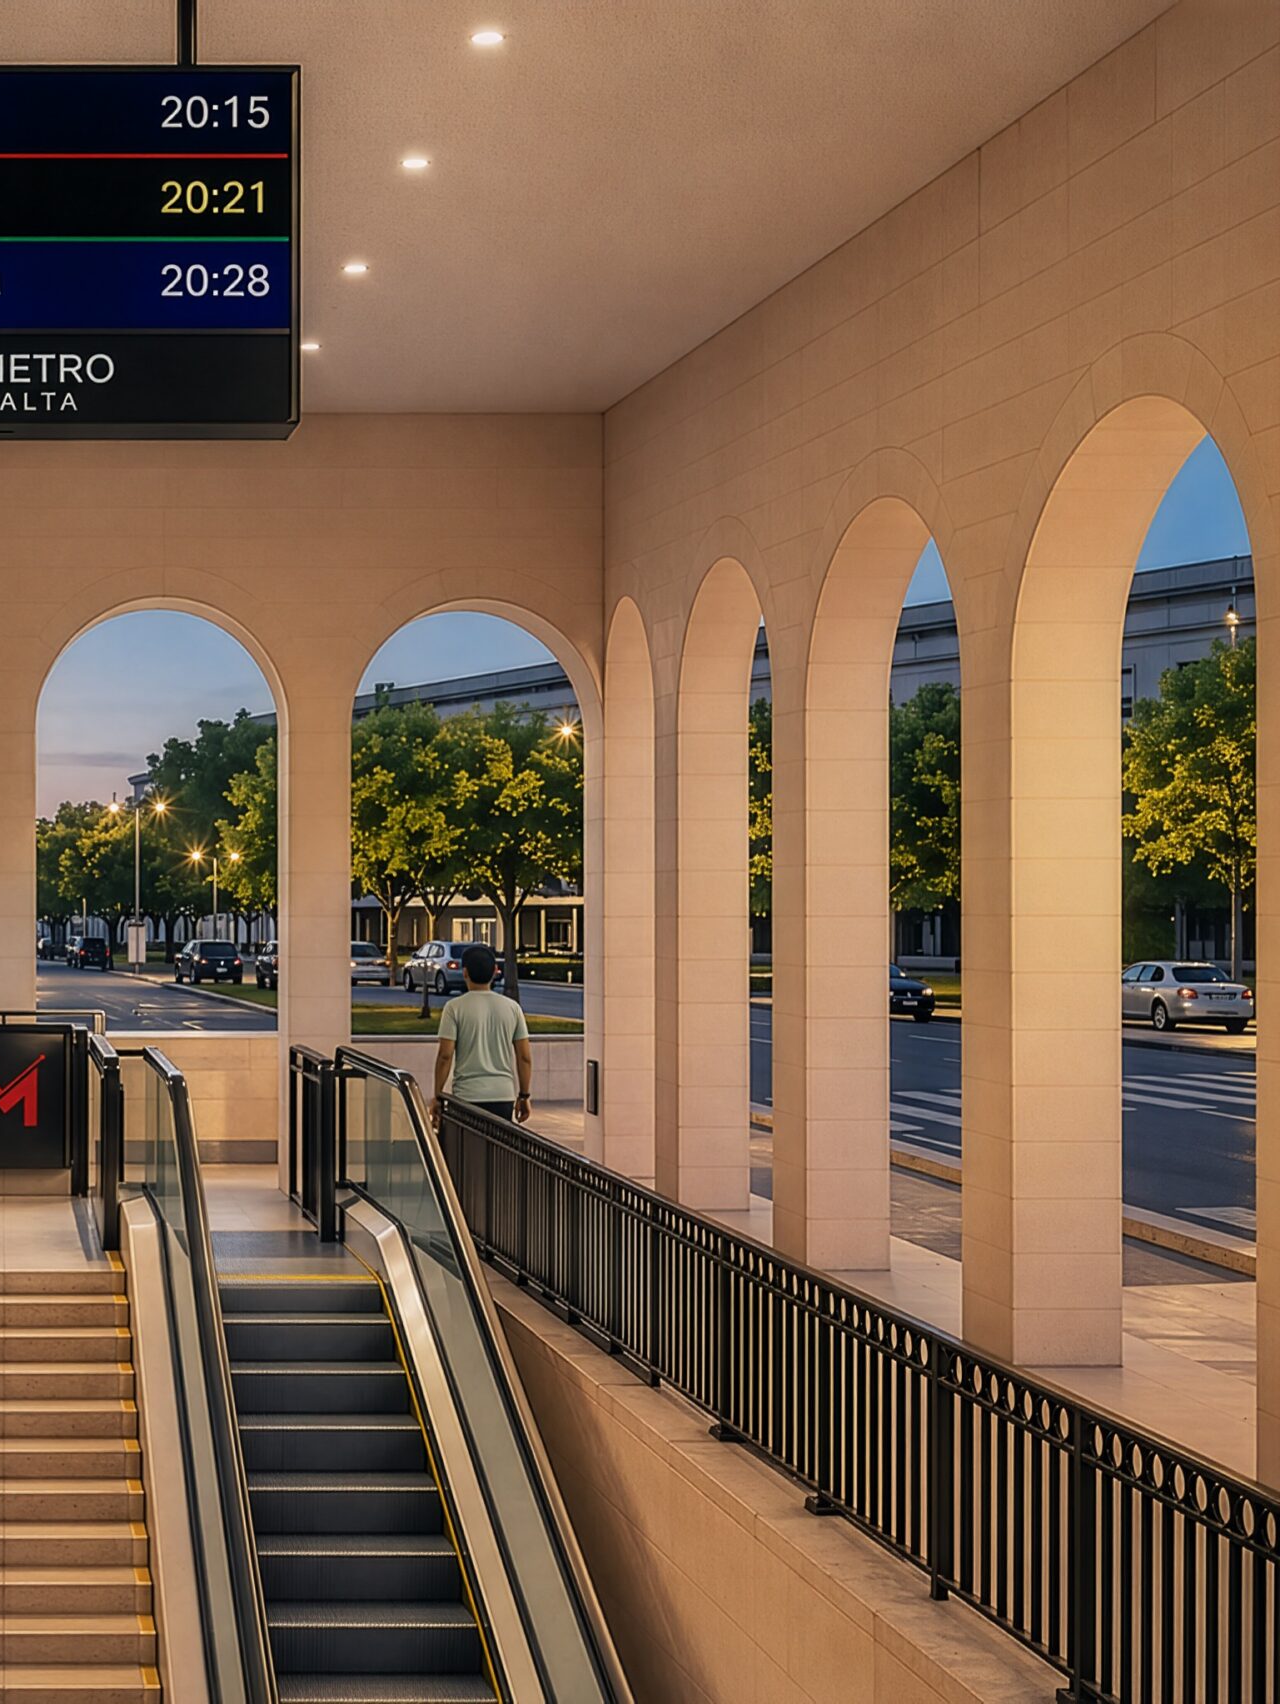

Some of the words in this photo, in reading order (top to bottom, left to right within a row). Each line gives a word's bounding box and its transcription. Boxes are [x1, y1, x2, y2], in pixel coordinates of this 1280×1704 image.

[161, 95, 270, 129] 20:15
[161, 180, 264, 214] 20:21
[161, 263, 270, 297] 20:28
